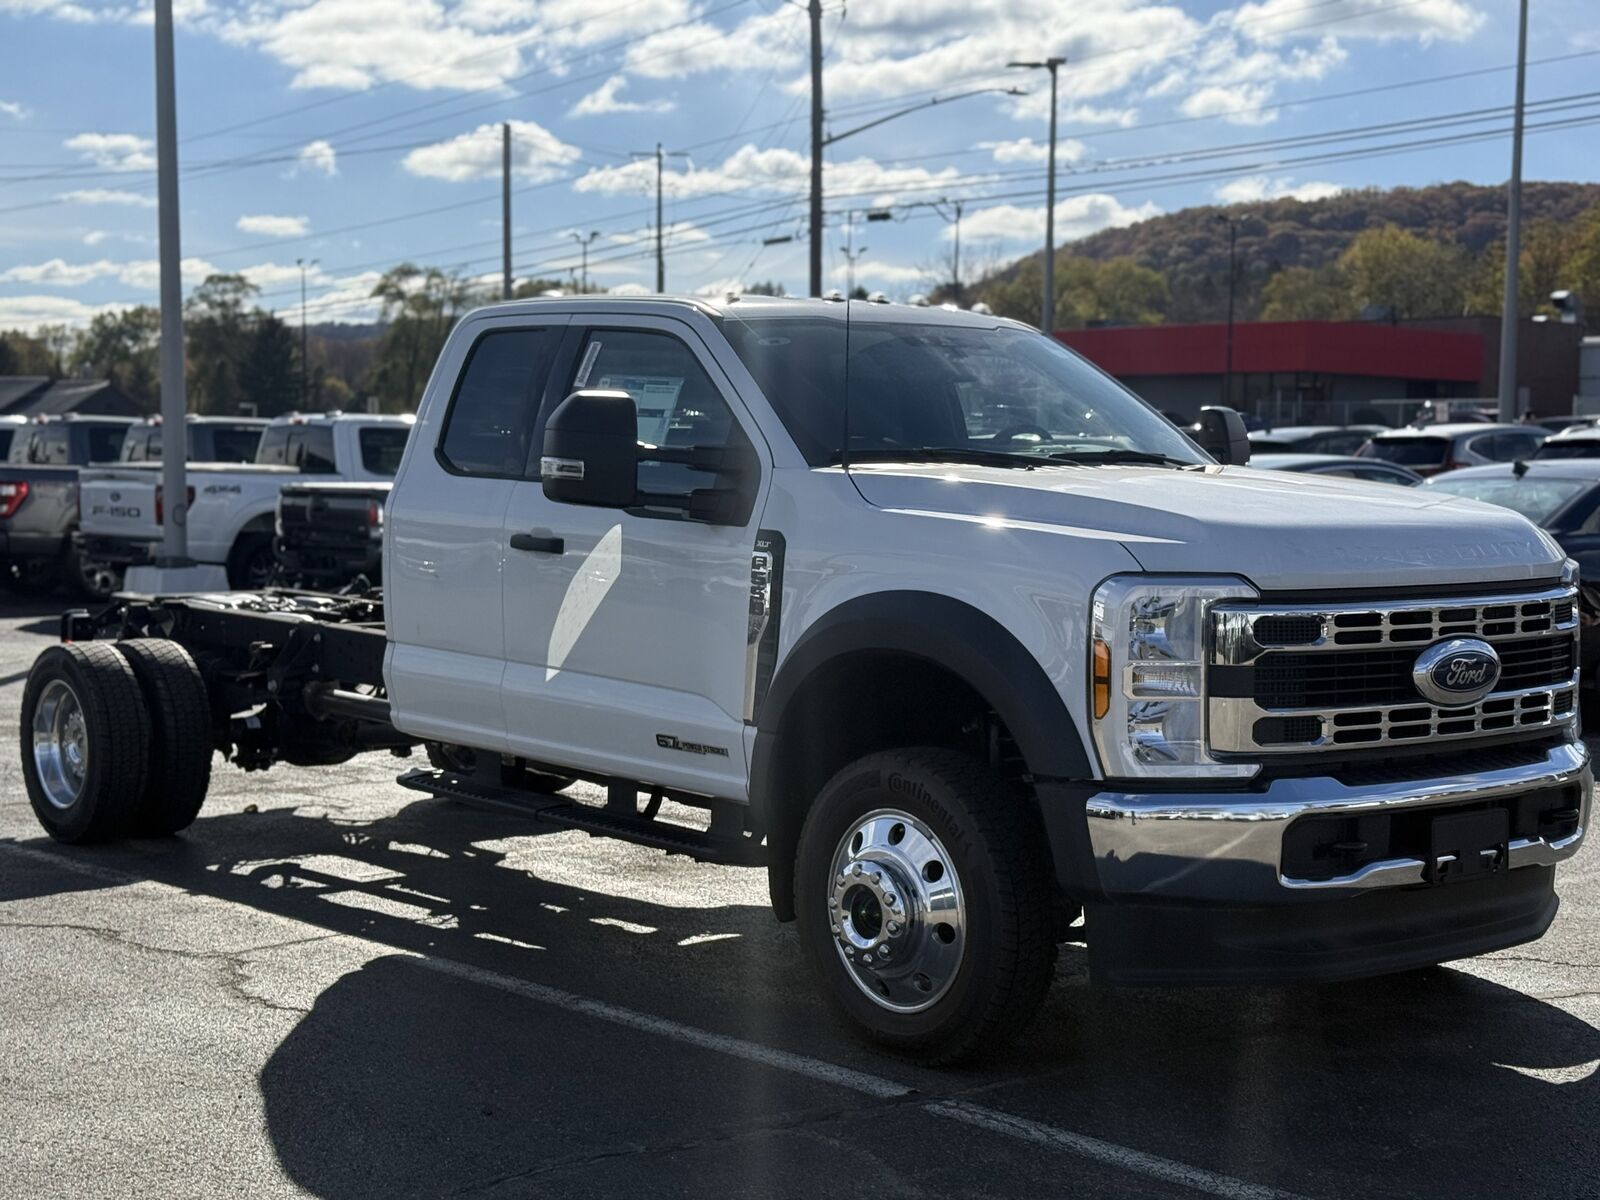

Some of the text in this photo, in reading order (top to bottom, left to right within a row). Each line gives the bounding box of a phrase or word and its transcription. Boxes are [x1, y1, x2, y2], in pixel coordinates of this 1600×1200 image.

[92, 506, 141, 518] F-150
[757, 540, 771, 548] XLT
[1446, 658, 1487, 686] Ford
[888, 772, 966, 841] Continental
